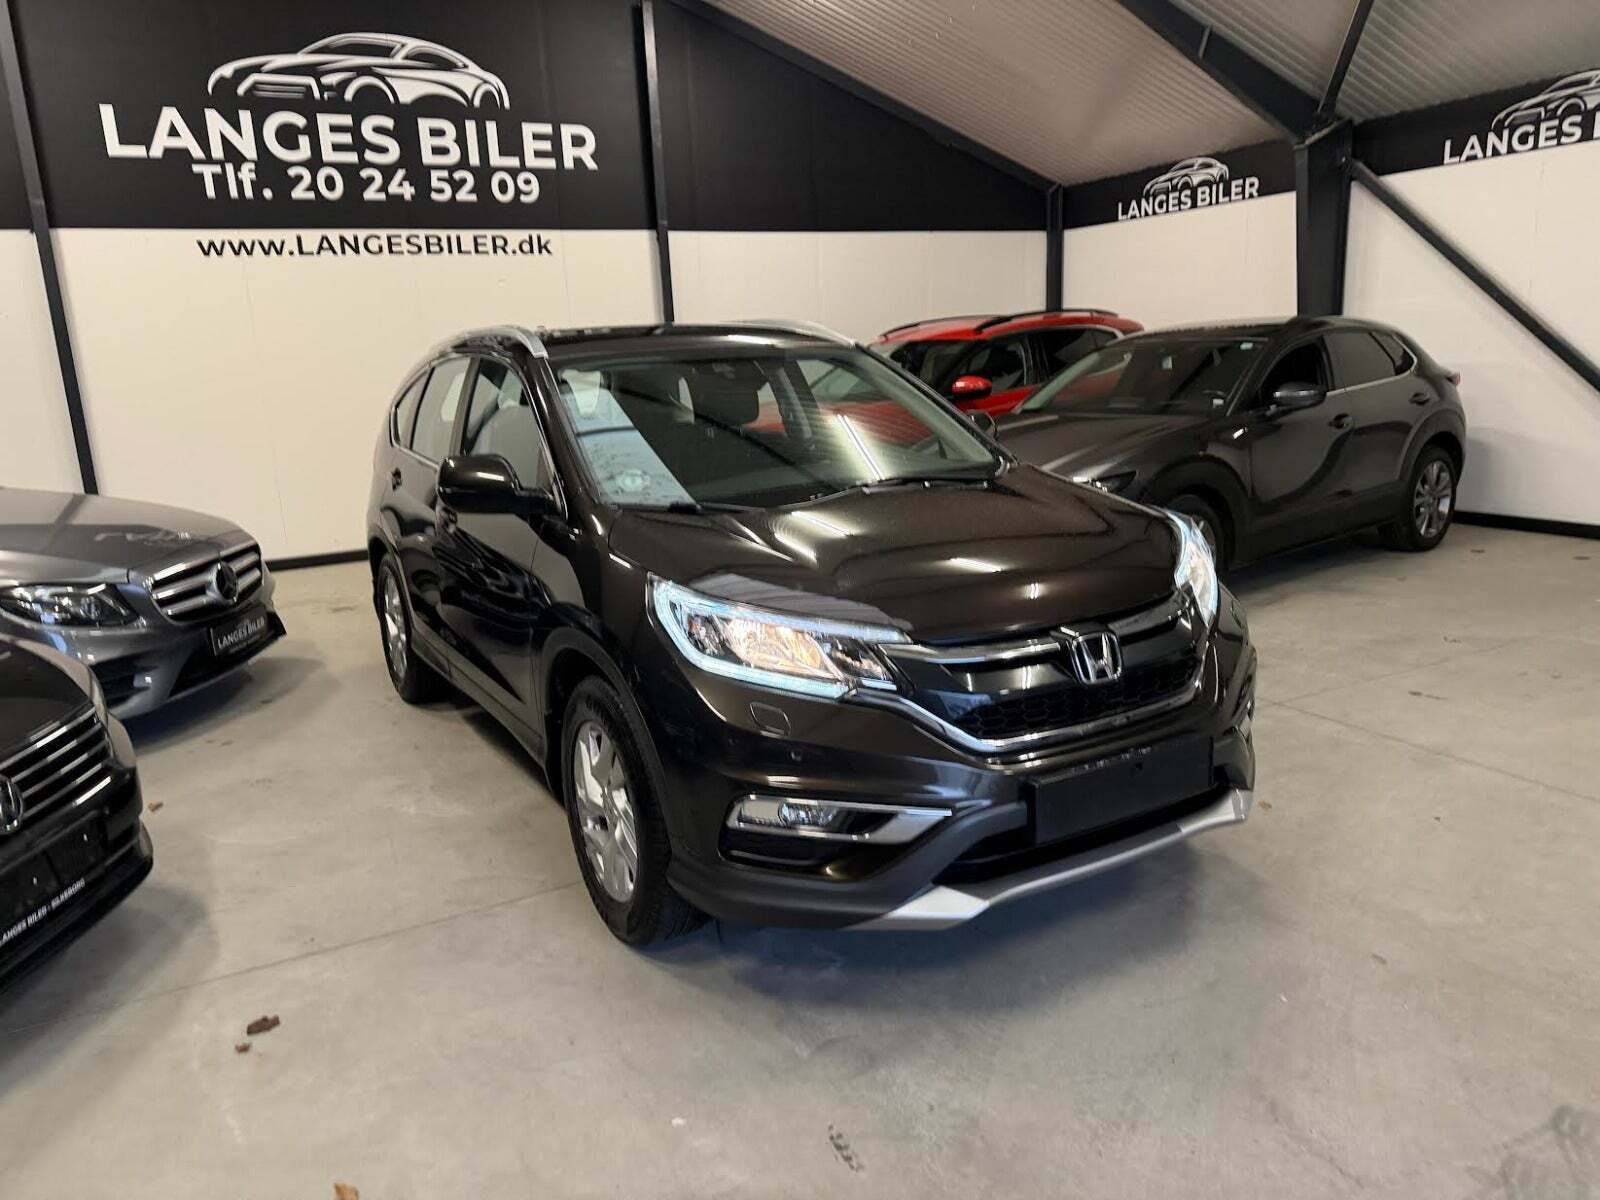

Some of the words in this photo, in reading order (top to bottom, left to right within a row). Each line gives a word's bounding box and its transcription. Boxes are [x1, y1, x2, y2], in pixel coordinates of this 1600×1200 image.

[98, 103, 401, 166] LANGES
[416, 116, 599, 171] BILER
[1443, 114, 1583, 165] LANGES
[191, 160, 274, 201] Tlf.
[286, 165, 345, 202] 20
[358, 167, 416, 203] 24
[429, 169, 478, 204] 52
[490, 170, 541, 205] 09
[1117, 188, 1192, 221] LANGES
[1197, 176, 1260, 208] BILER
[196, 233, 553, 258] www.LANGESBILER.dk
